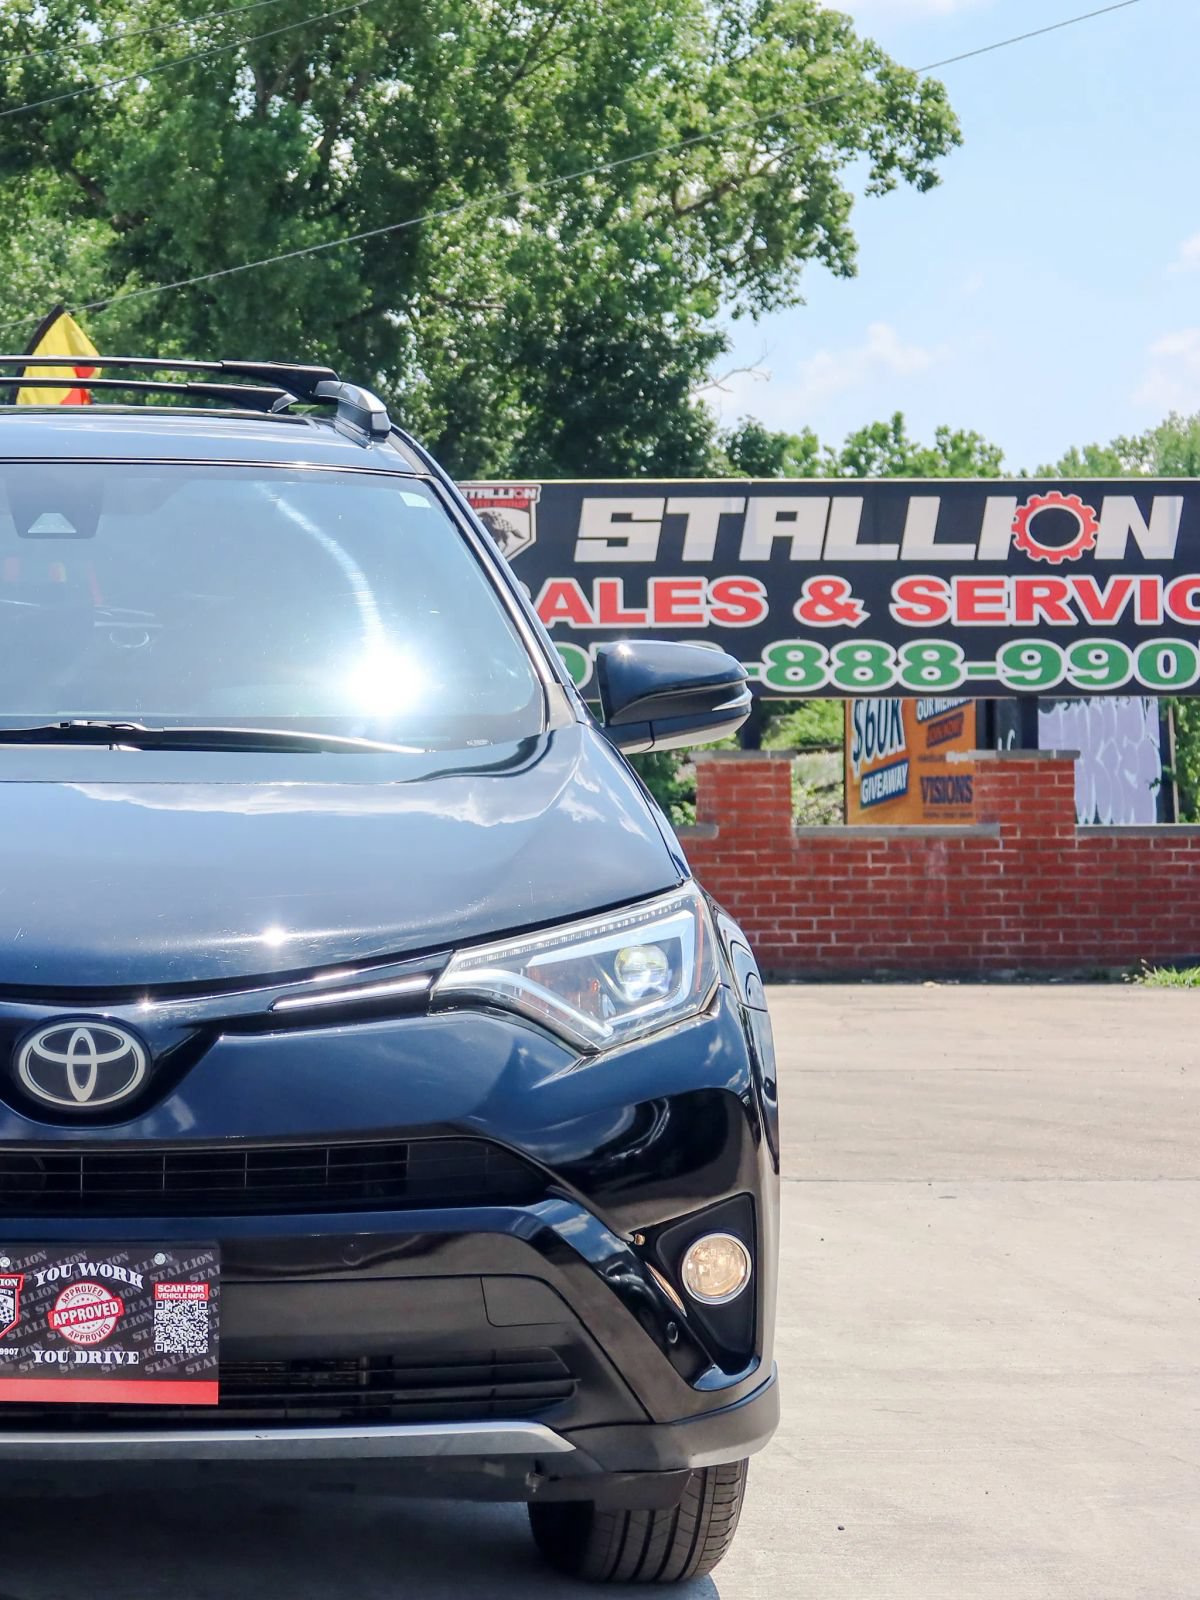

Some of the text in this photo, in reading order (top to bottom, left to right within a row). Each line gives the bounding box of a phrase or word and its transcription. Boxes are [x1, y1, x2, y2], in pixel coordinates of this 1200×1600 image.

[574, 490, 1184, 565] STALLION
[519, 576, 769, 628] ALES
[793, 575, 871, 629] &
[861, 764, 908, 804] GIVEAWAY
[34, 1262, 144, 1290] YOU WORK
[61, 1284, 104, 1304] APPROVED
[157, 1284, 205, 1293] SCAN FOR
[157, 1292, 205, 1300] VEHICLE INFO
[53, 1301, 119, 1327] APPROVED
[67, 1323, 111, 1342] APPROVED
[32, 1350, 140, 1365] YOU DRIVE
